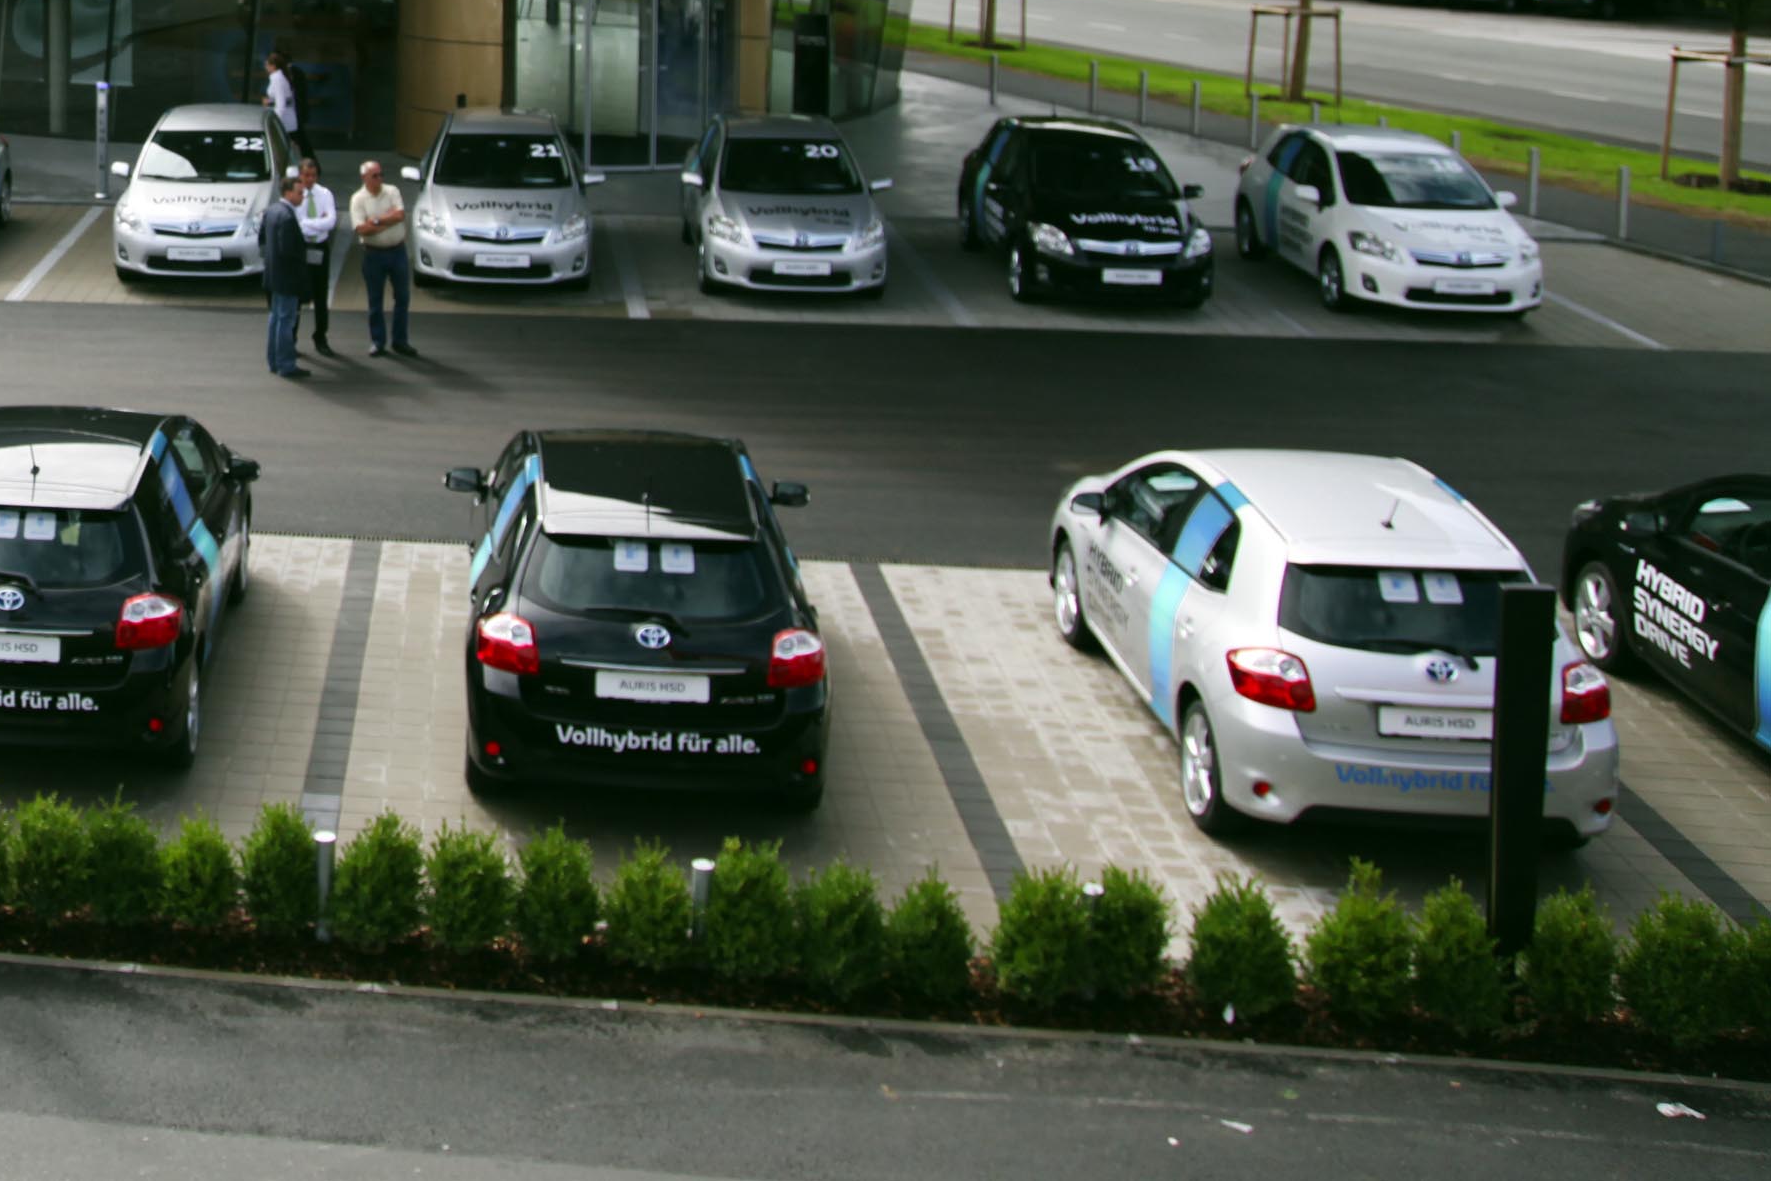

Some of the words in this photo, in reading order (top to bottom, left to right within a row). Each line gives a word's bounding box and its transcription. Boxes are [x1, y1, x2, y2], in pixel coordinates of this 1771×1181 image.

[232, 137, 264, 151] 22
[529, 144, 563, 158] 21
[803, 144, 839, 158] 20
[152, 195, 247, 205] Vollhybrid
[454, 200, 553, 212] Vollhybrid
[747, 205, 851, 218] Vollhybrid
[1069, 212, 1179, 227] Vollhybrid
[1088, 539, 1124, 595] HYBRID
[1636, 559, 1706, 623] HYBRID
[1633, 585, 1719, 661] SYNERGY
[1634, 612, 1692, 669] DRIVE
[13, 643, 39, 653] HSD
[618, 679, 657, 692] AURIS
[659, 680, 686, 693] HSD
[20, 690, 52, 710] für
[56, 692, 100, 711] alle.
[1404, 715, 1444, 728] AURIS
[1447, 717, 1476, 729] HSD
[555, 724, 672, 753] Vollhybrid
[677, 731, 712, 753] für
[715, 733, 761, 754] alle.
[1335, 764, 1463, 793] Vollhybrid
